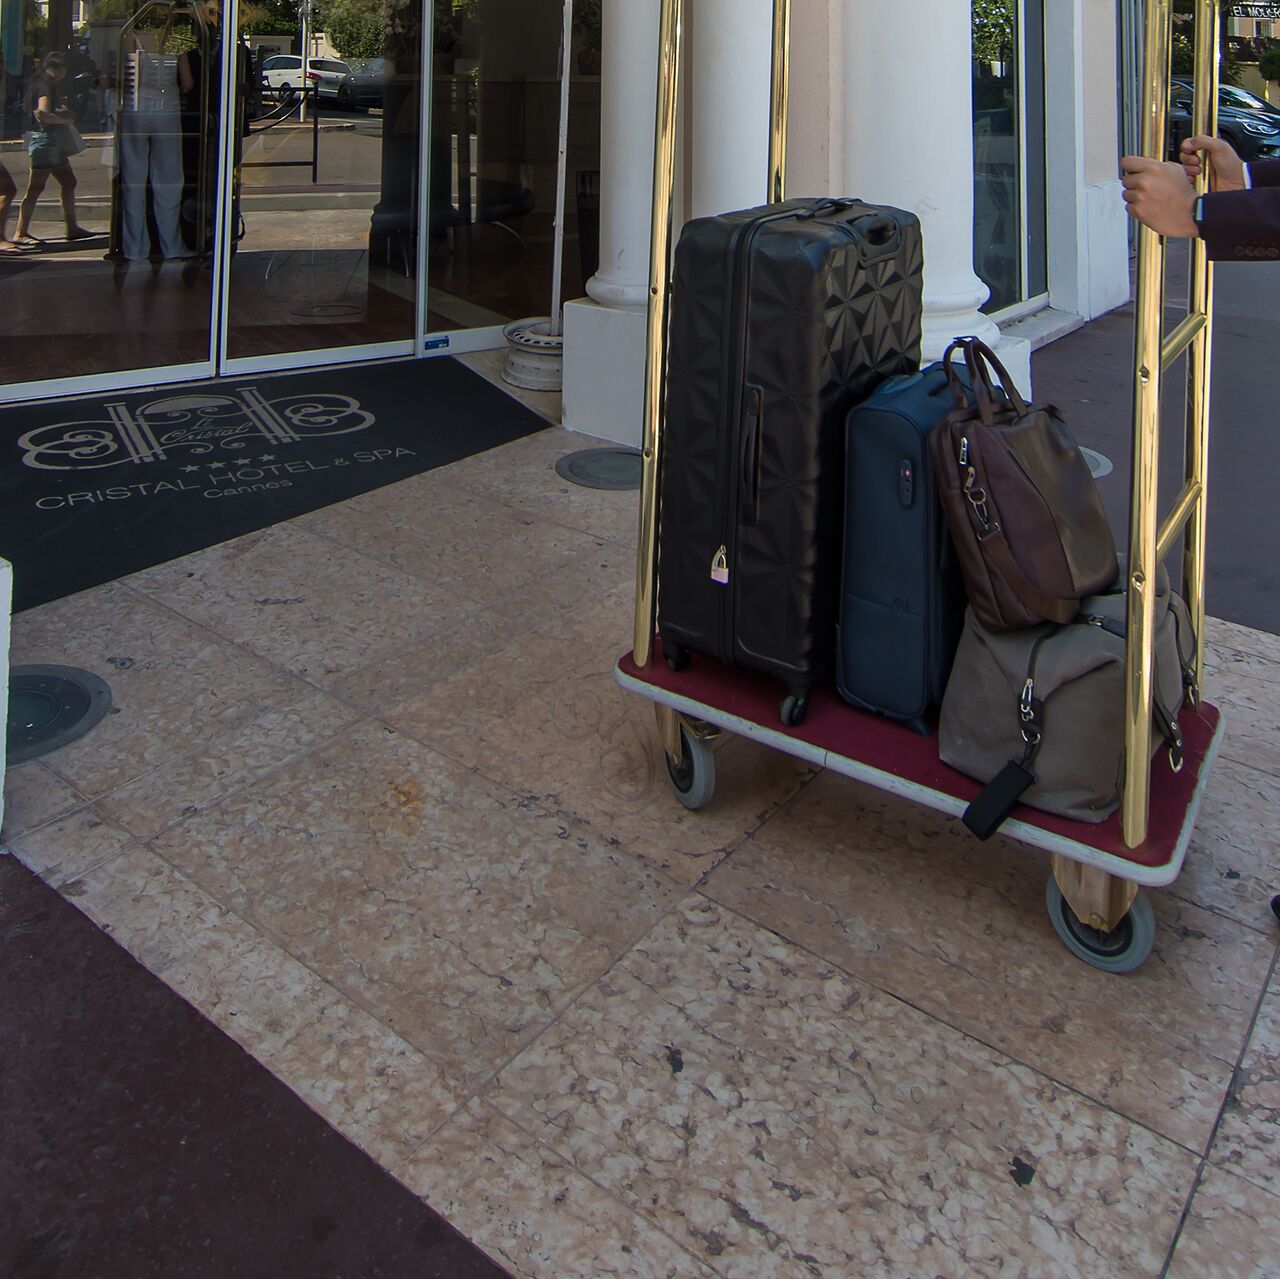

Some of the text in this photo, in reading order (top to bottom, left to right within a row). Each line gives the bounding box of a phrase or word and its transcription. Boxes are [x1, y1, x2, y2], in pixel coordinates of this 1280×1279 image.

[36, 477, 201, 510] CRISTAL
[334, 456, 351, 466] &
[353, 446, 417, 465] SPA
[203, 478, 294, 500] Cannes
